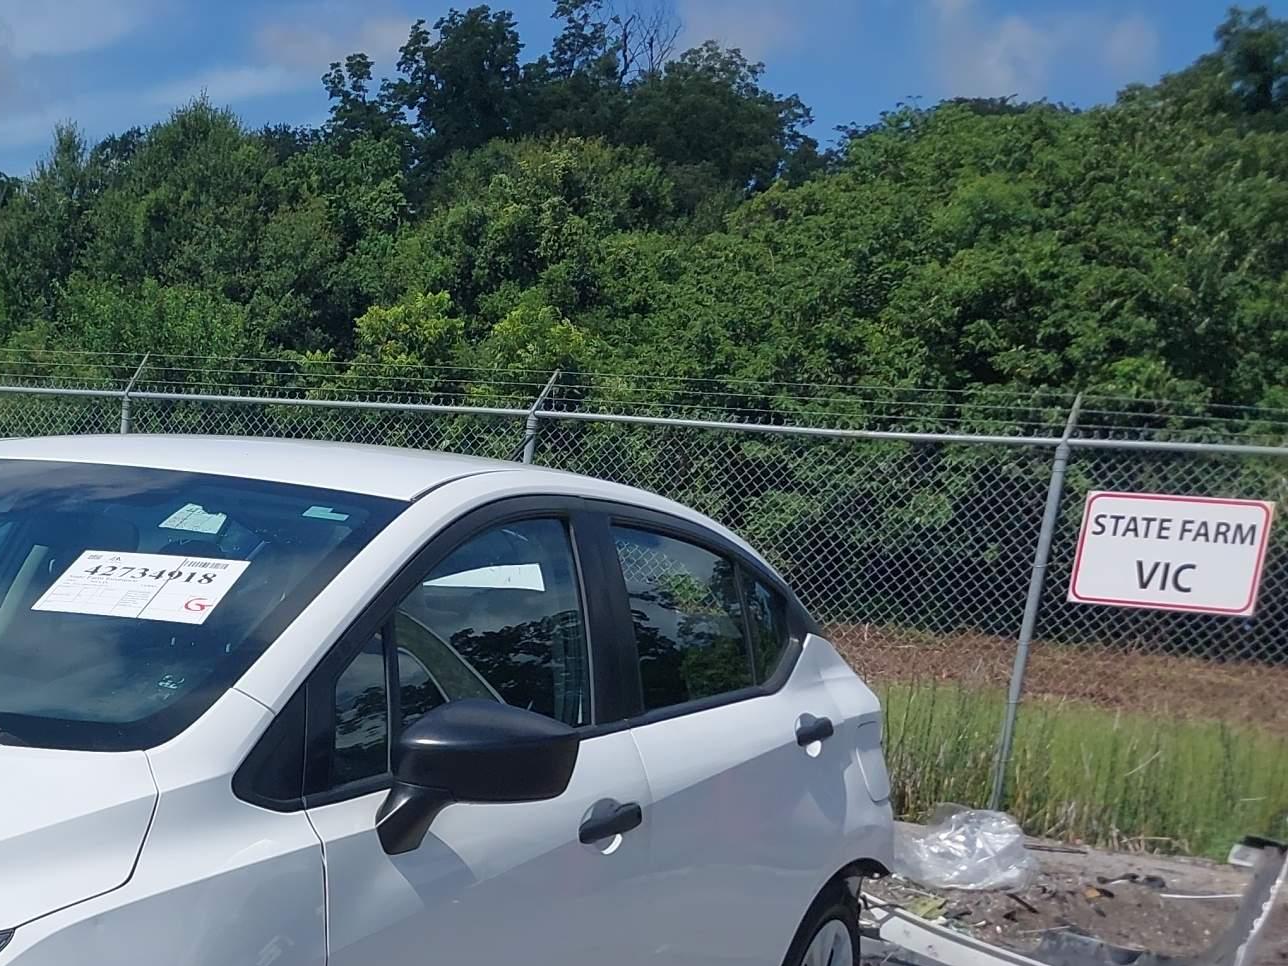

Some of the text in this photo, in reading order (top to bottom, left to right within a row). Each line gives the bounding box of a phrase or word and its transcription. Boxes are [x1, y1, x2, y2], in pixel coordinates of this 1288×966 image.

[1092, 514, 1257, 546] STATE FARM
[83, 564, 217, 585] 42734918
[1135, 560, 1197, 593] VIC
